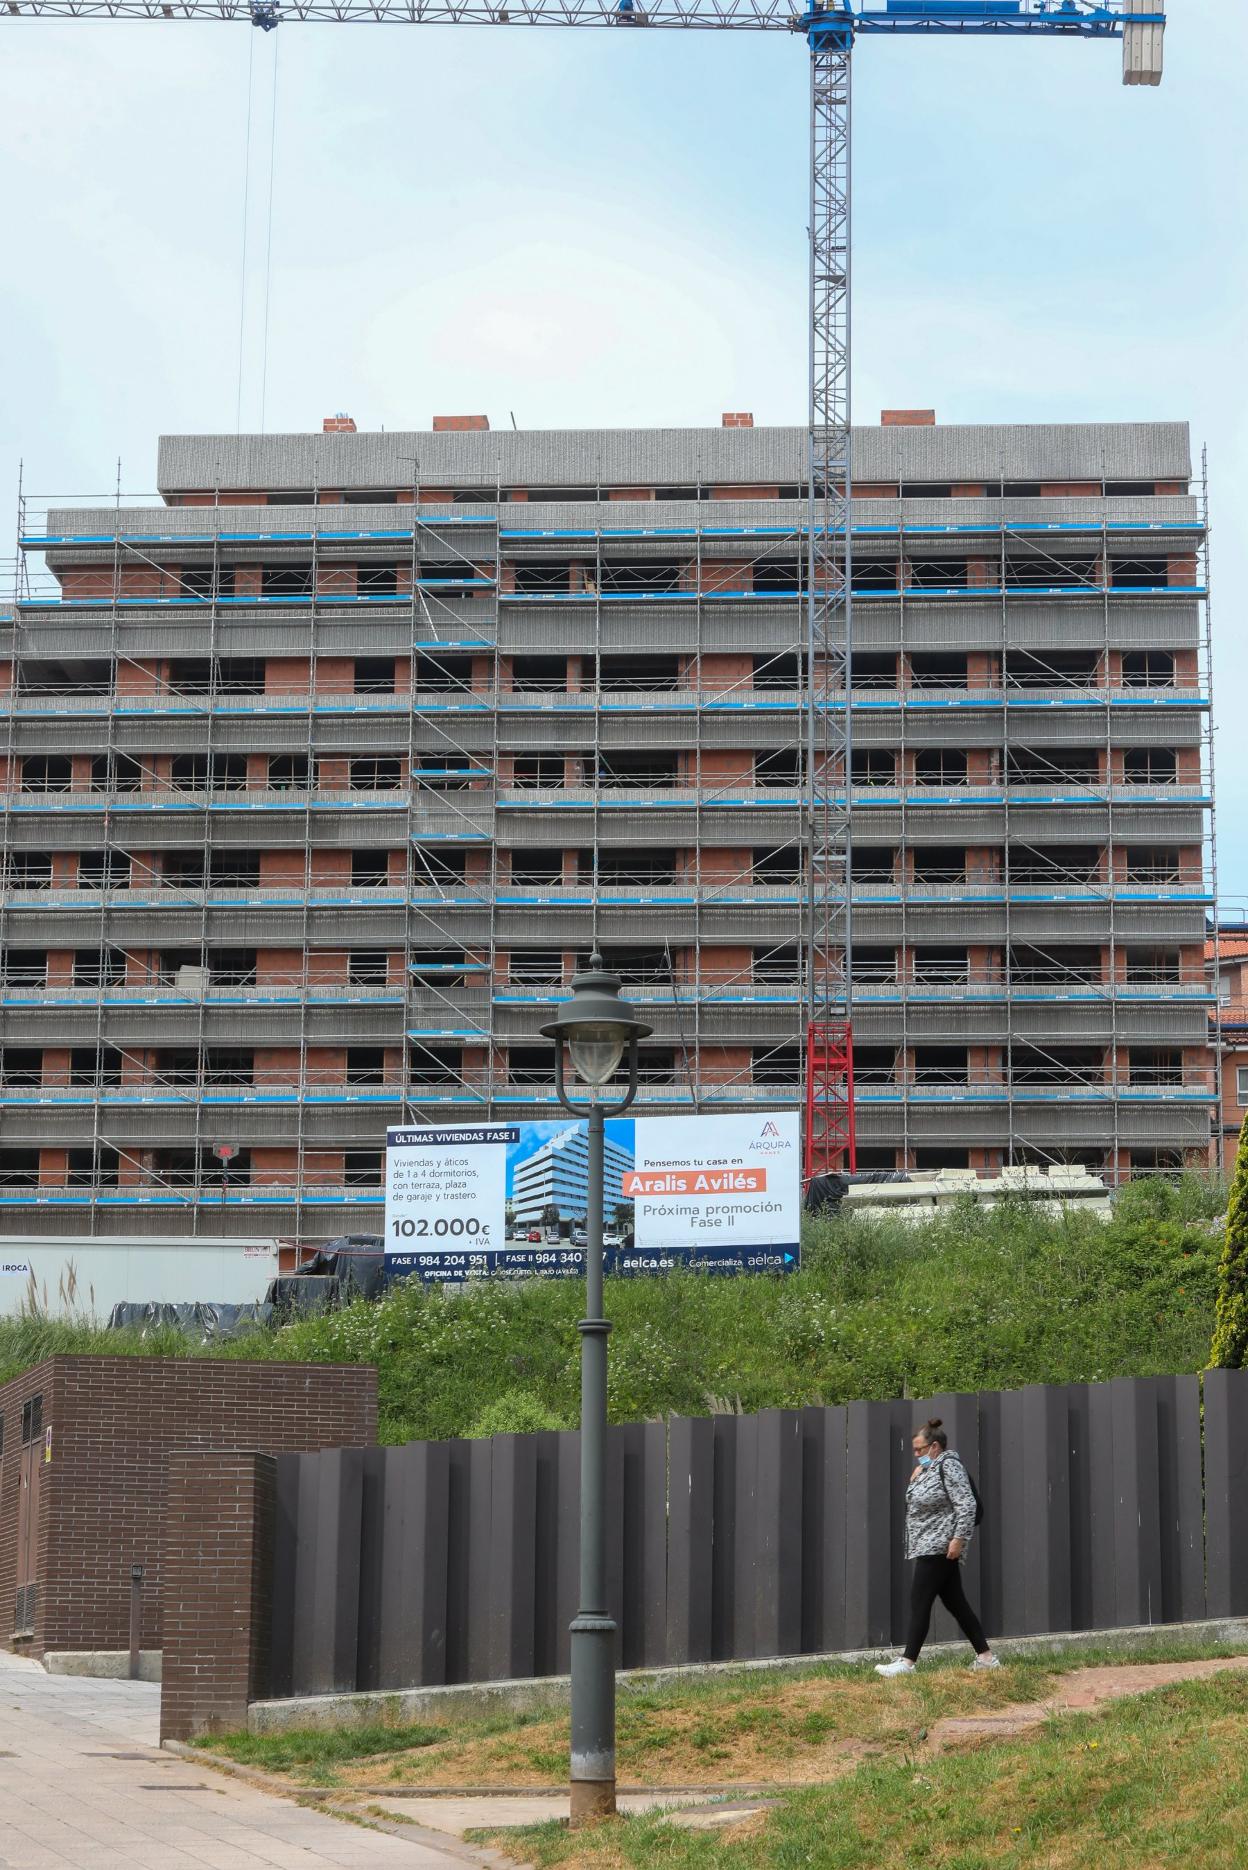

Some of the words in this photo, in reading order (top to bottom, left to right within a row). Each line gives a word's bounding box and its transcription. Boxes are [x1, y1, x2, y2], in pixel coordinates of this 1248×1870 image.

[395, 1133, 434, 1143] ÚLTIMAS
[436, 1132, 485, 1142] VIVIENDAS
[487, 1131, 510, 1140] FASE
[512, 1131, 516, 1140] I
[393, 1158, 434, 1167] Viviendas
[436, 1160, 442, 1169] y
[444, 1158, 469, 1166] áticos
[644, 1159, 691, 1167] Pensemos
[393, 1170, 404, 1179] de
[407, 1170, 411, 1178] 1
[420, 1170, 427, 1178] 4
[429, 1169, 480, 1179] dormitorios,
[392, 1182, 408, 1190] con
[411, 1181, 443, 1190] terraza,
[445, 1180, 467, 1190] plaza
[628, 1174, 687, 1193] Aralis
[694, 1172, 757, 1191] Avilés
[392, 1192, 404, 1201] de
[406, 1192, 433, 1203] garaje
[436, 1193, 441, 1202] y
[443, 1192, 478, 1200] trastero.
[643, 1204, 700, 1216] Próxima
[706, 1201, 783, 1217] promoción
[690, 1216, 722, 1228] Fase
[728, 1215, 735, 1226] II
[475, 1238, 490, 1246] IVA
[391, 1257, 412, 1265] FASE
[420, 1256, 440, 1266] 984
[444, 1255, 466, 1266] 204
[469, 1254, 488, 1265] 951
[506, 1254, 527, 1262] FASE
[528, 1254, 533, 1262] II
[535, 1253, 556, 1264] 984
[560, 1252, 582, 1263] 340
[622, 1256, 674, 1268] aelca.es
[688, 1258, 743, 1268] Comercializa
[748, 1253, 782, 1266] aelca
[424, 1270, 452, 1278] OFICINA
